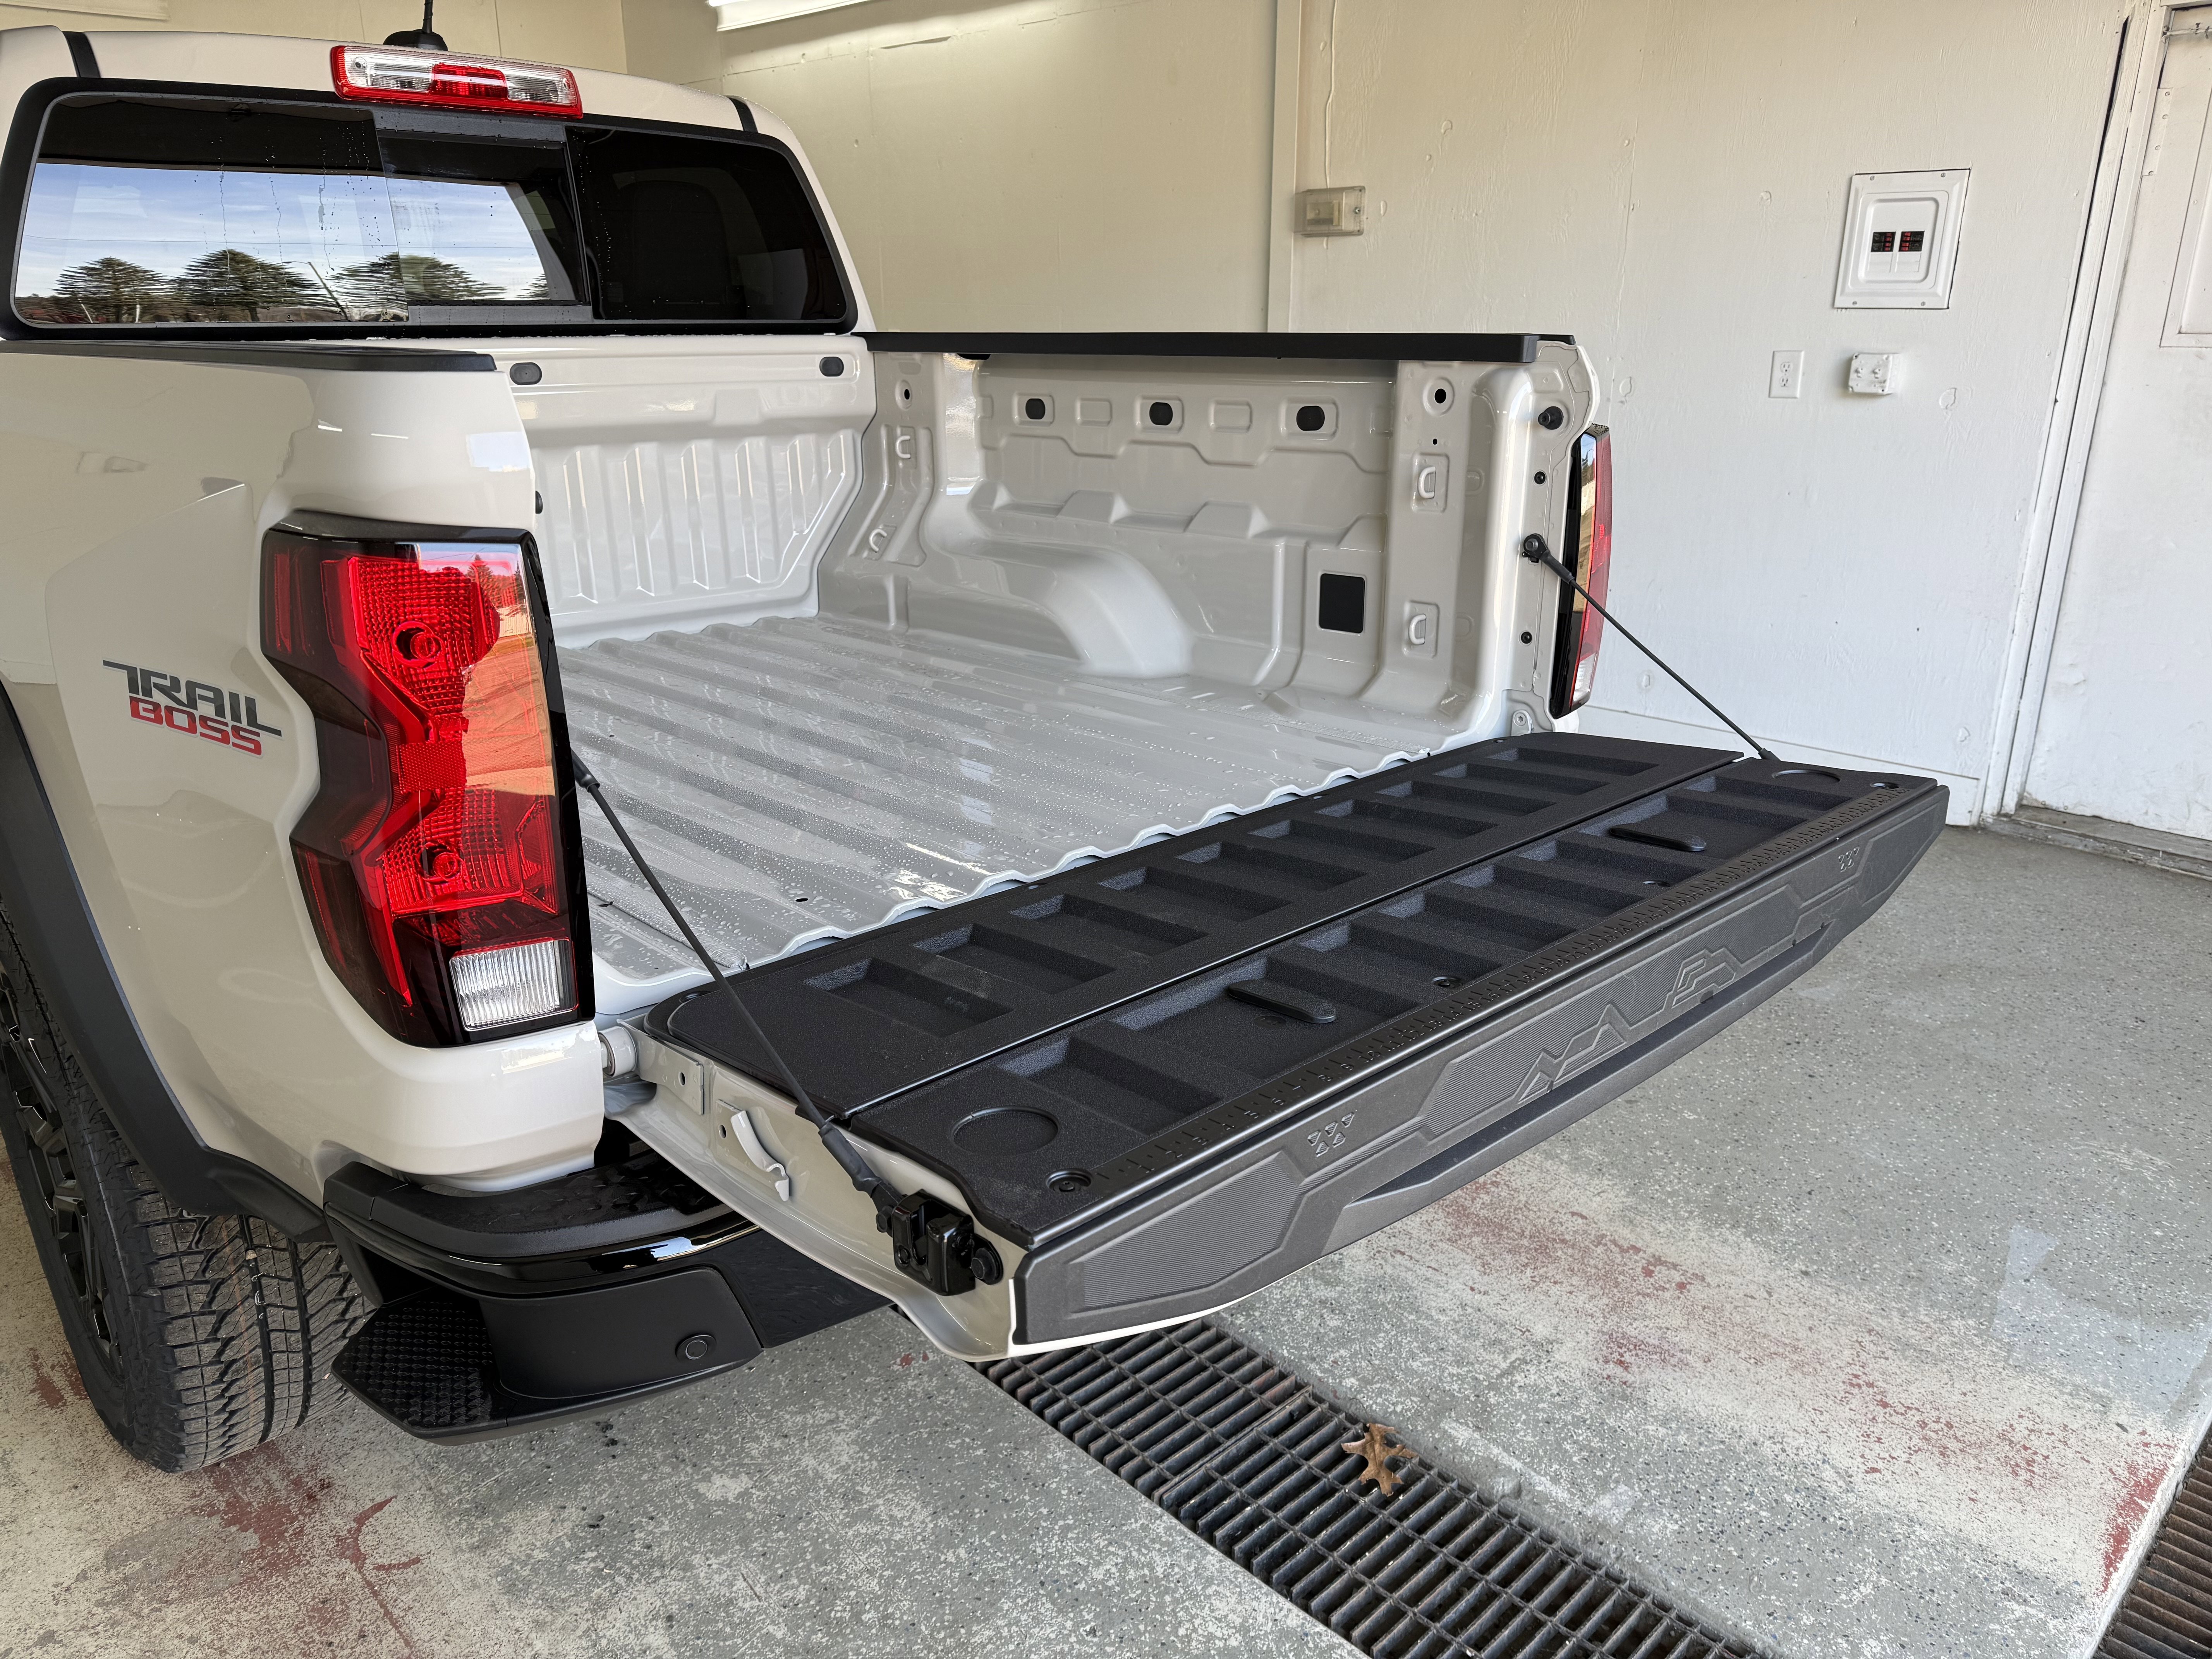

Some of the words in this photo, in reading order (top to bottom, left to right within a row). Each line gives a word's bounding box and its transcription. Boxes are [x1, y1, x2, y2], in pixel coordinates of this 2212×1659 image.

[103, 659, 282, 737] TRAIL
[129, 696, 262, 756] BOSS
[1137, 1165, 1155, 1173] 1
[1165, 1151, 1183, 1159] 2
[1192, 1137, 1209, 1146] 3
[1244, 1110, 1259, 1118] 5
[1358, 1050, 1381, 1063] 10
[1380, 1041, 1404, 1051] 11
[1401, 1030, 1425, 1041] 12
[1422, 1020, 1443, 1031] 13
[1441, 1011, 1462, 1022] 14
[1461, 1001, 1482, 1012] 15
[1479, 992, 1500, 1002] 16
[1498, 983, 1517, 993] 17
[1516, 975, 1537, 984] 18
[1533, 967, 1553, 975] 19
[1549, 959, 1570, 967] 20
[1658, 905, 1675, 914] 27
